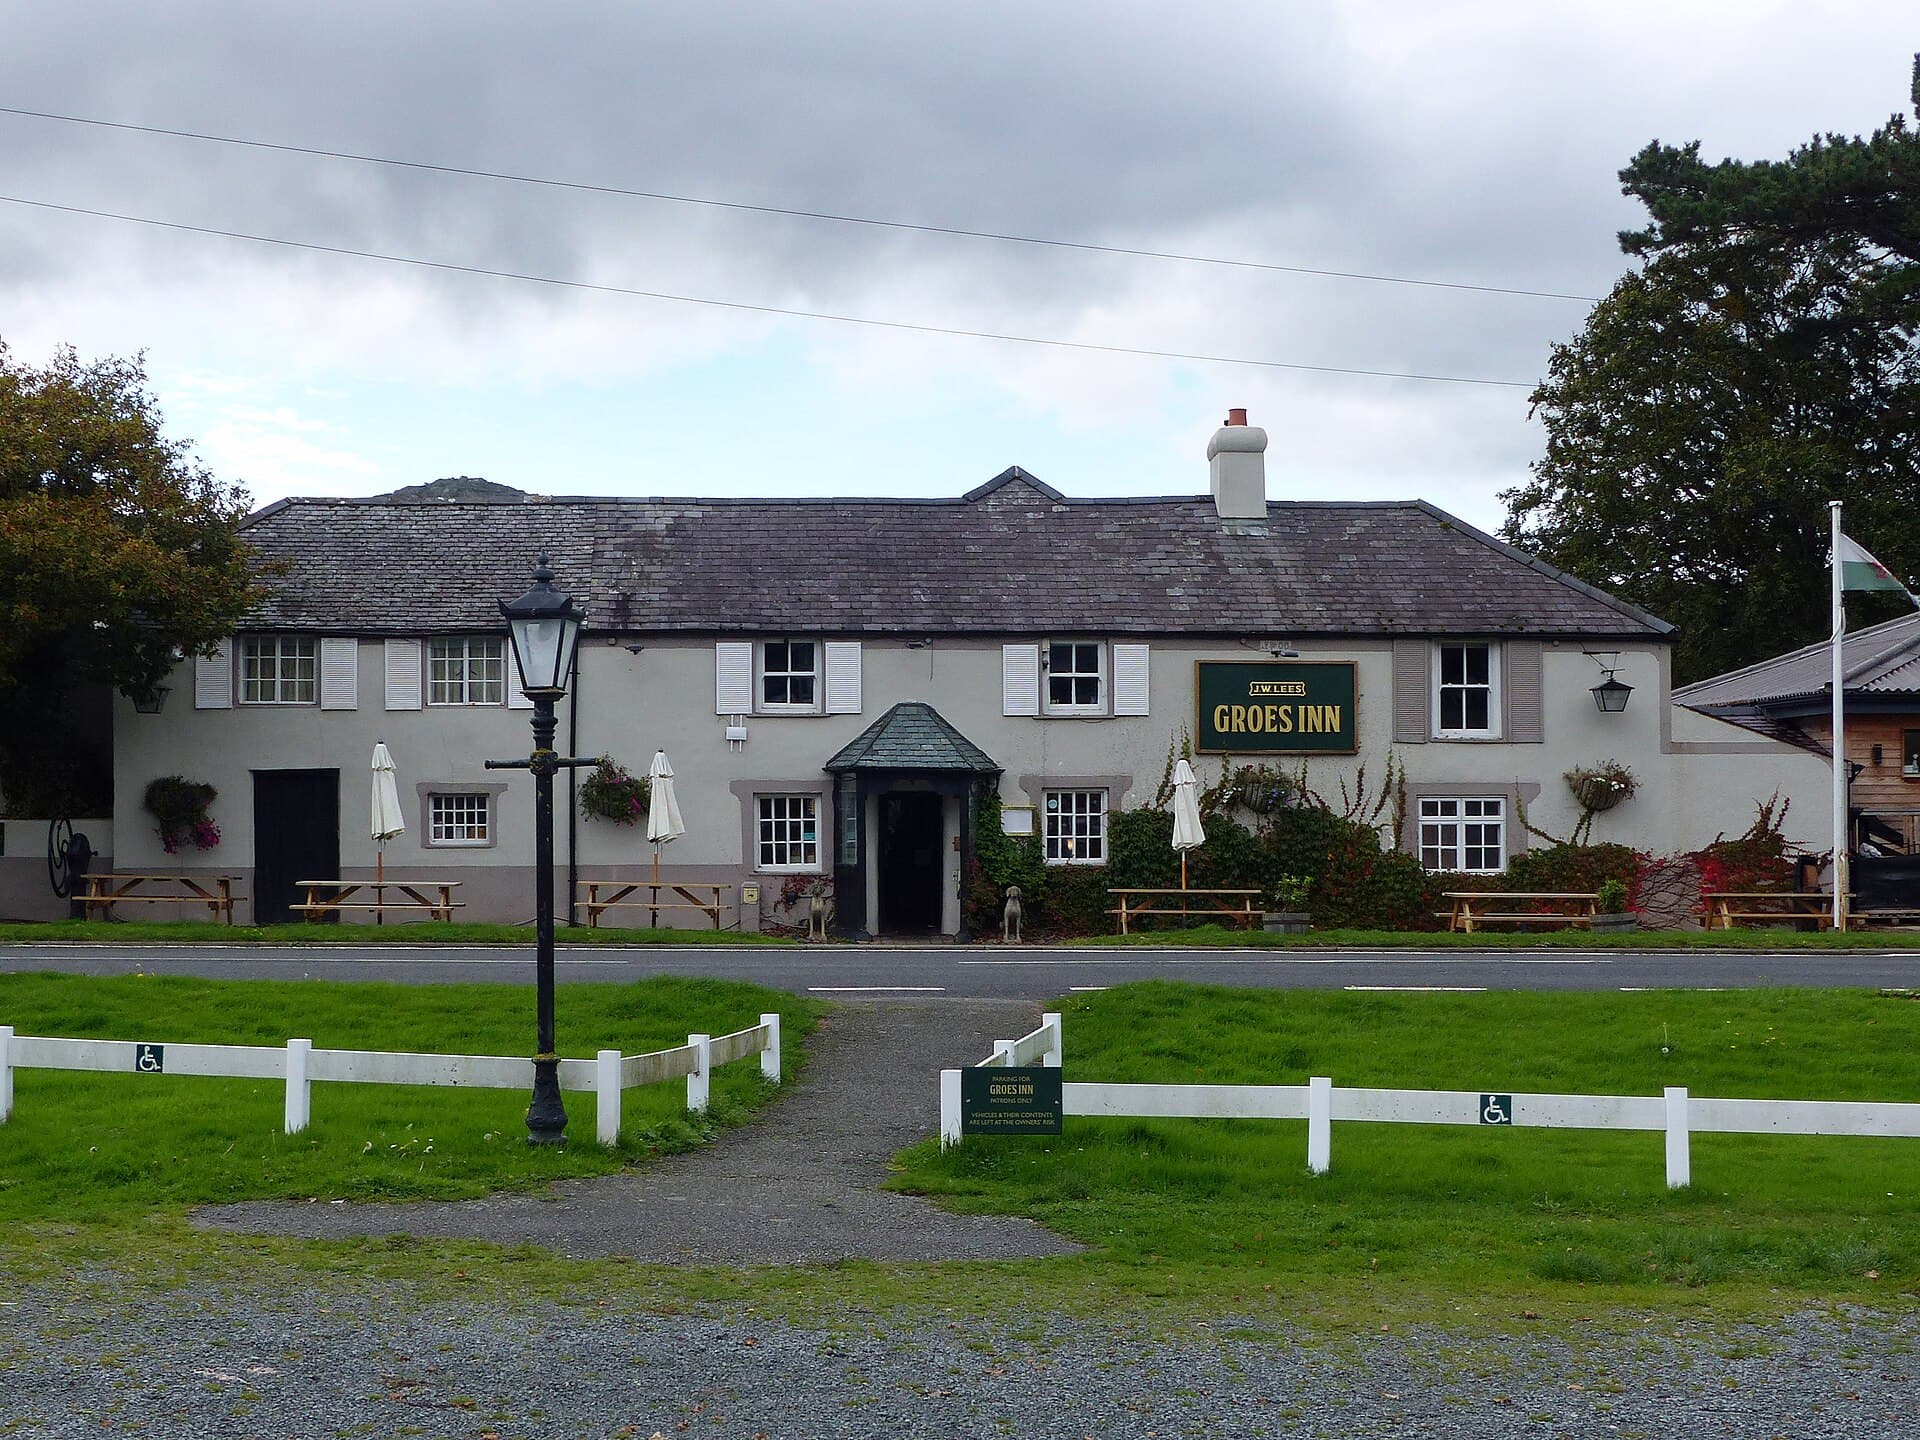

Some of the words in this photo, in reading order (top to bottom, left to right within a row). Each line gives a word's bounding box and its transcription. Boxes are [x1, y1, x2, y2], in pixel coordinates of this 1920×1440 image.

[1213, 704, 1293, 734] GROES
[1298, 704, 1342, 734] INN
[989, 1084, 1017, 1095] GROES
[1018, 1084, 1034, 1095] INN
